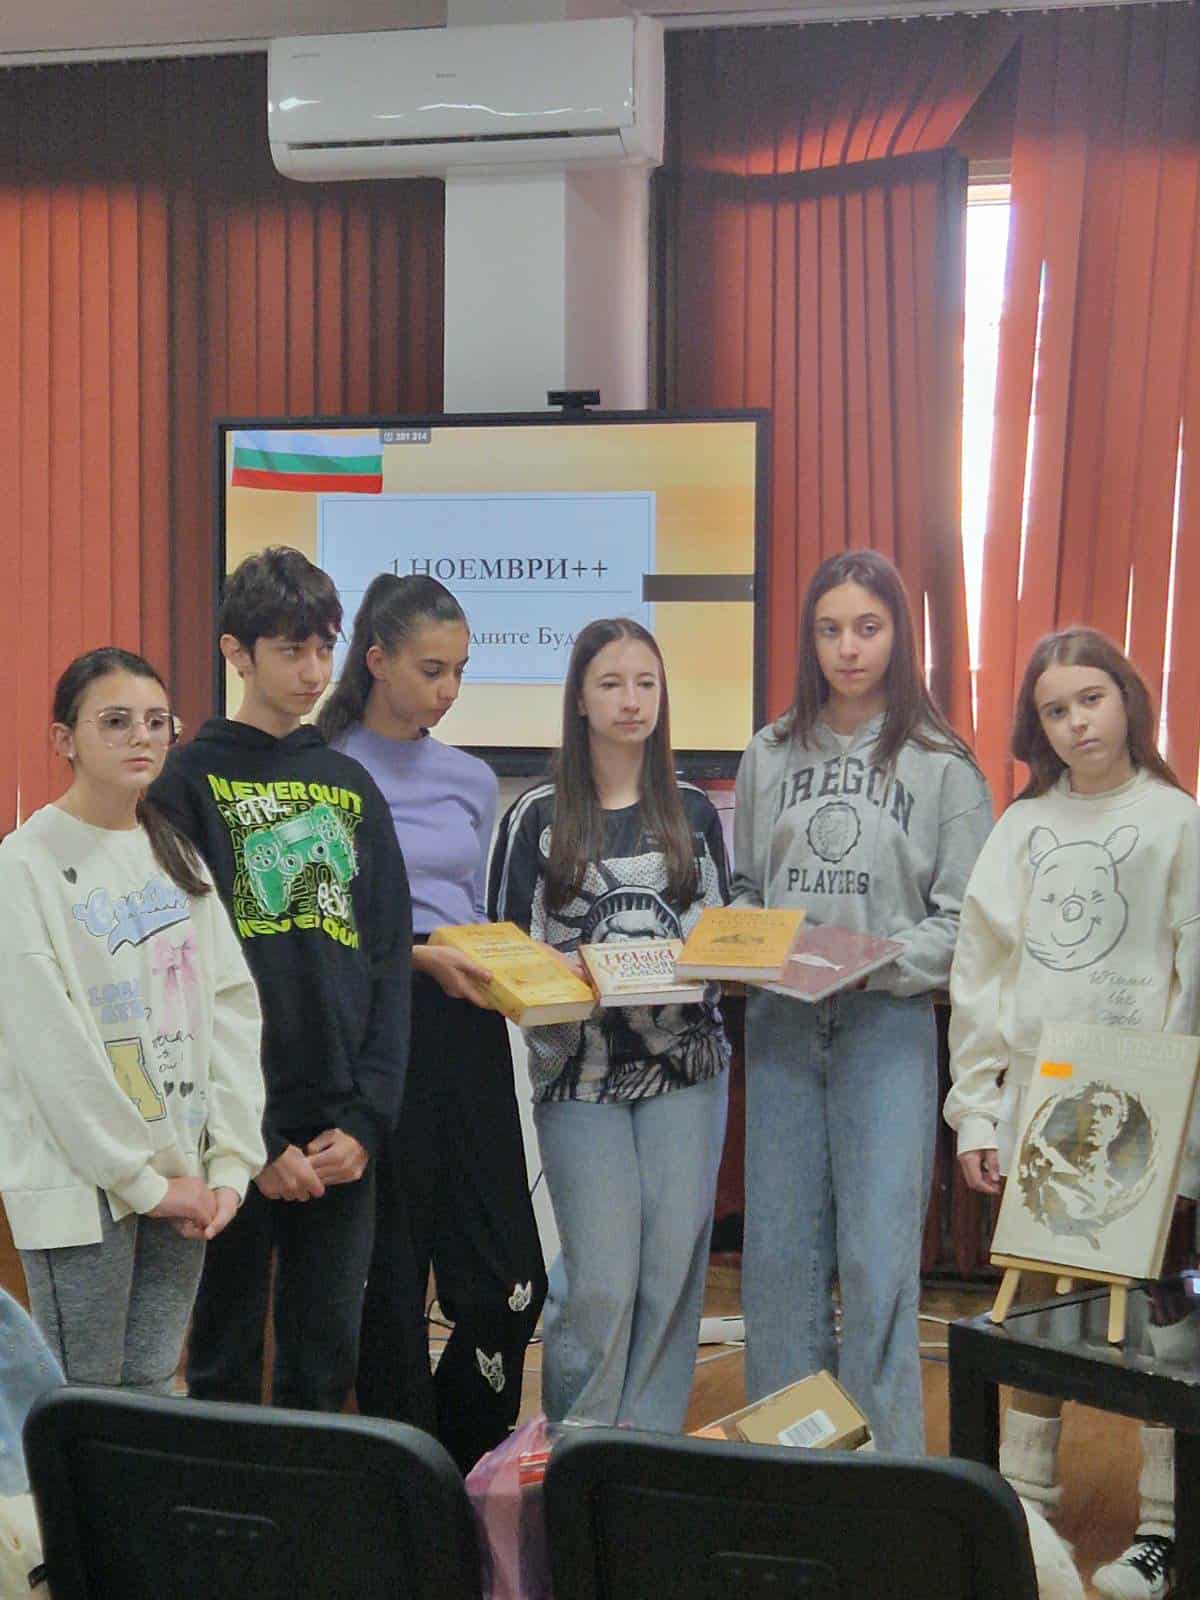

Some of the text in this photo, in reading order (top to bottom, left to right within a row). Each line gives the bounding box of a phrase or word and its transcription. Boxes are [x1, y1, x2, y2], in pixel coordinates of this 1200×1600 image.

[467, 626, 576, 651] дните Буд
[207, 774, 309, 804] NEVER
[308, 783, 362, 815] QUIT
